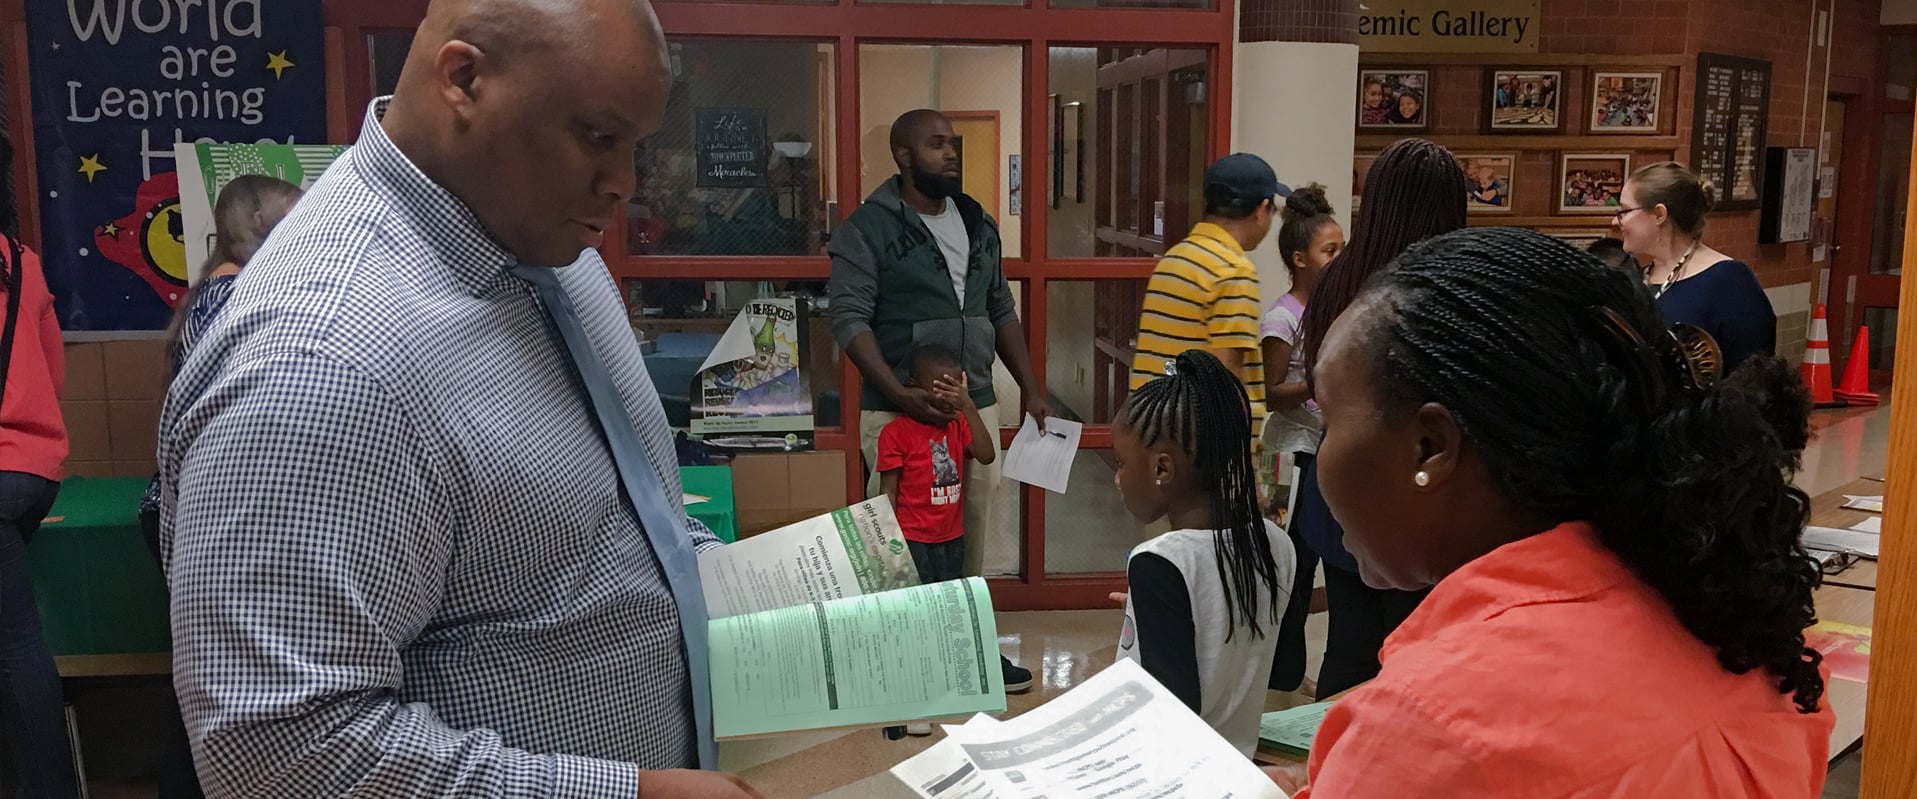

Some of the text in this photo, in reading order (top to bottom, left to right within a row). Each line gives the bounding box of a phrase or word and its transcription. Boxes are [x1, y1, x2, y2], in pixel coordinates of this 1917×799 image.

[67, 0, 262, 45] World
[1431, 10, 1530, 43] Gallery
[160, 45, 237, 80] are
[67, 81, 265, 125] Learning
[863, 502, 888, 546] girl scouts
[809, 547, 817, 556] tu
[812, 556, 823, 570] hija
[815, 535, 835, 571] Comienza
[829, 571, 840, 586] una
[820, 577, 830, 591] sus
[954, 637, 978, 697] School
[980, 750, 1011, 761] STAY
